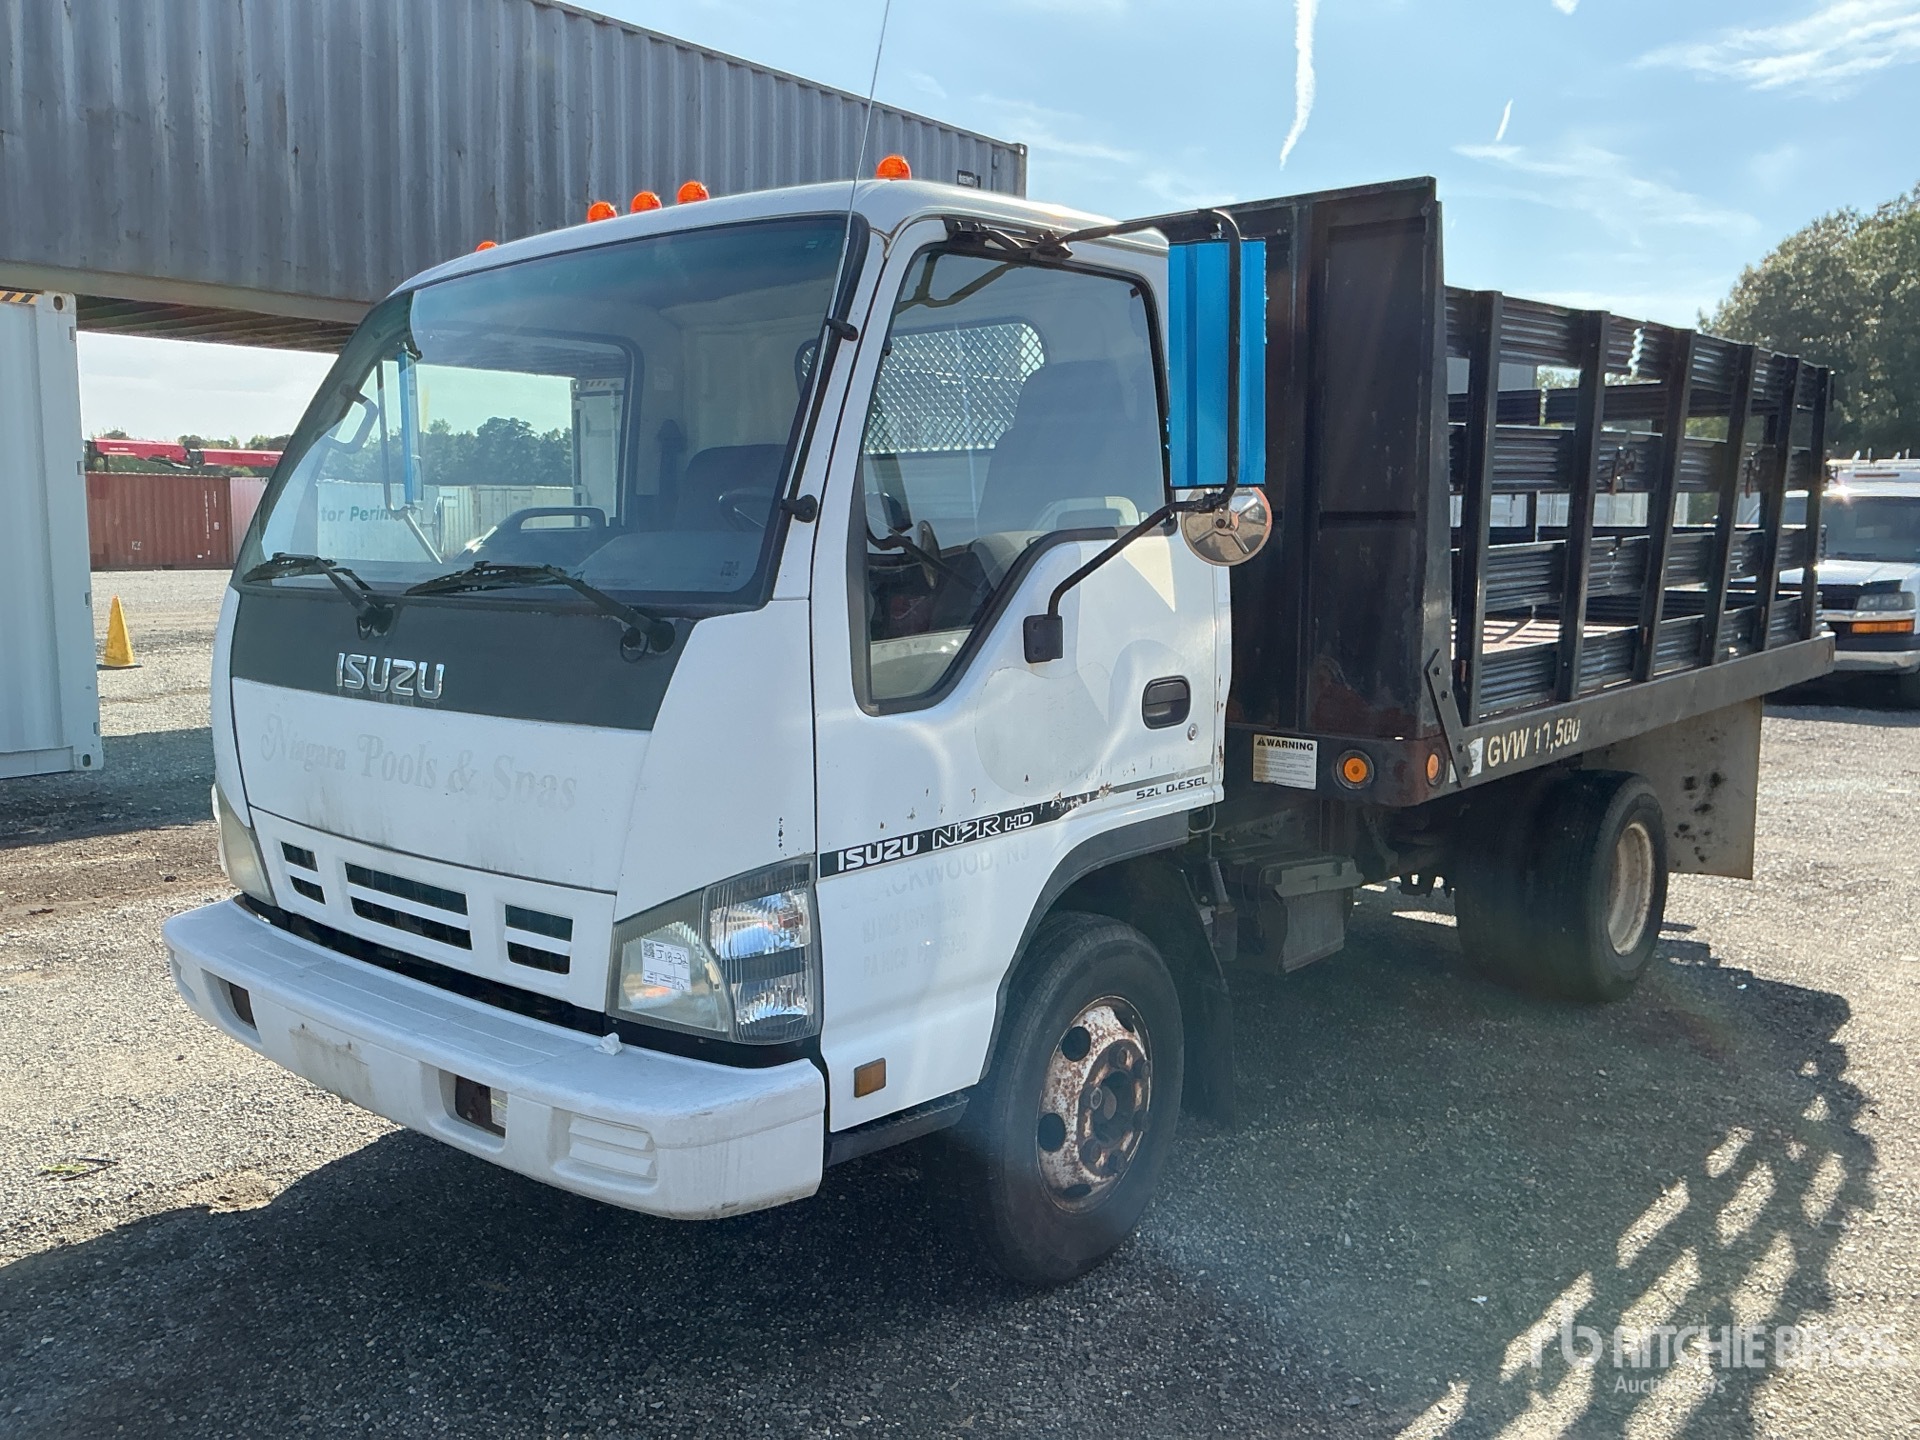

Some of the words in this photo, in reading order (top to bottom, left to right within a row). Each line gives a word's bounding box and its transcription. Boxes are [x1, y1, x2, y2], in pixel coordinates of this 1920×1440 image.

[336, 652, 444, 700] ISUZU
[357, 733, 438, 789] Pools
[447, 749, 477, 795] &
[1266, 738, 1314, 751] WARNING
[1487, 727, 1530, 768] GVW
[837, 834, 919, 872] ISUZU
[932, 815, 1001, 850] NPR
[1004, 812, 1034, 831] HD
